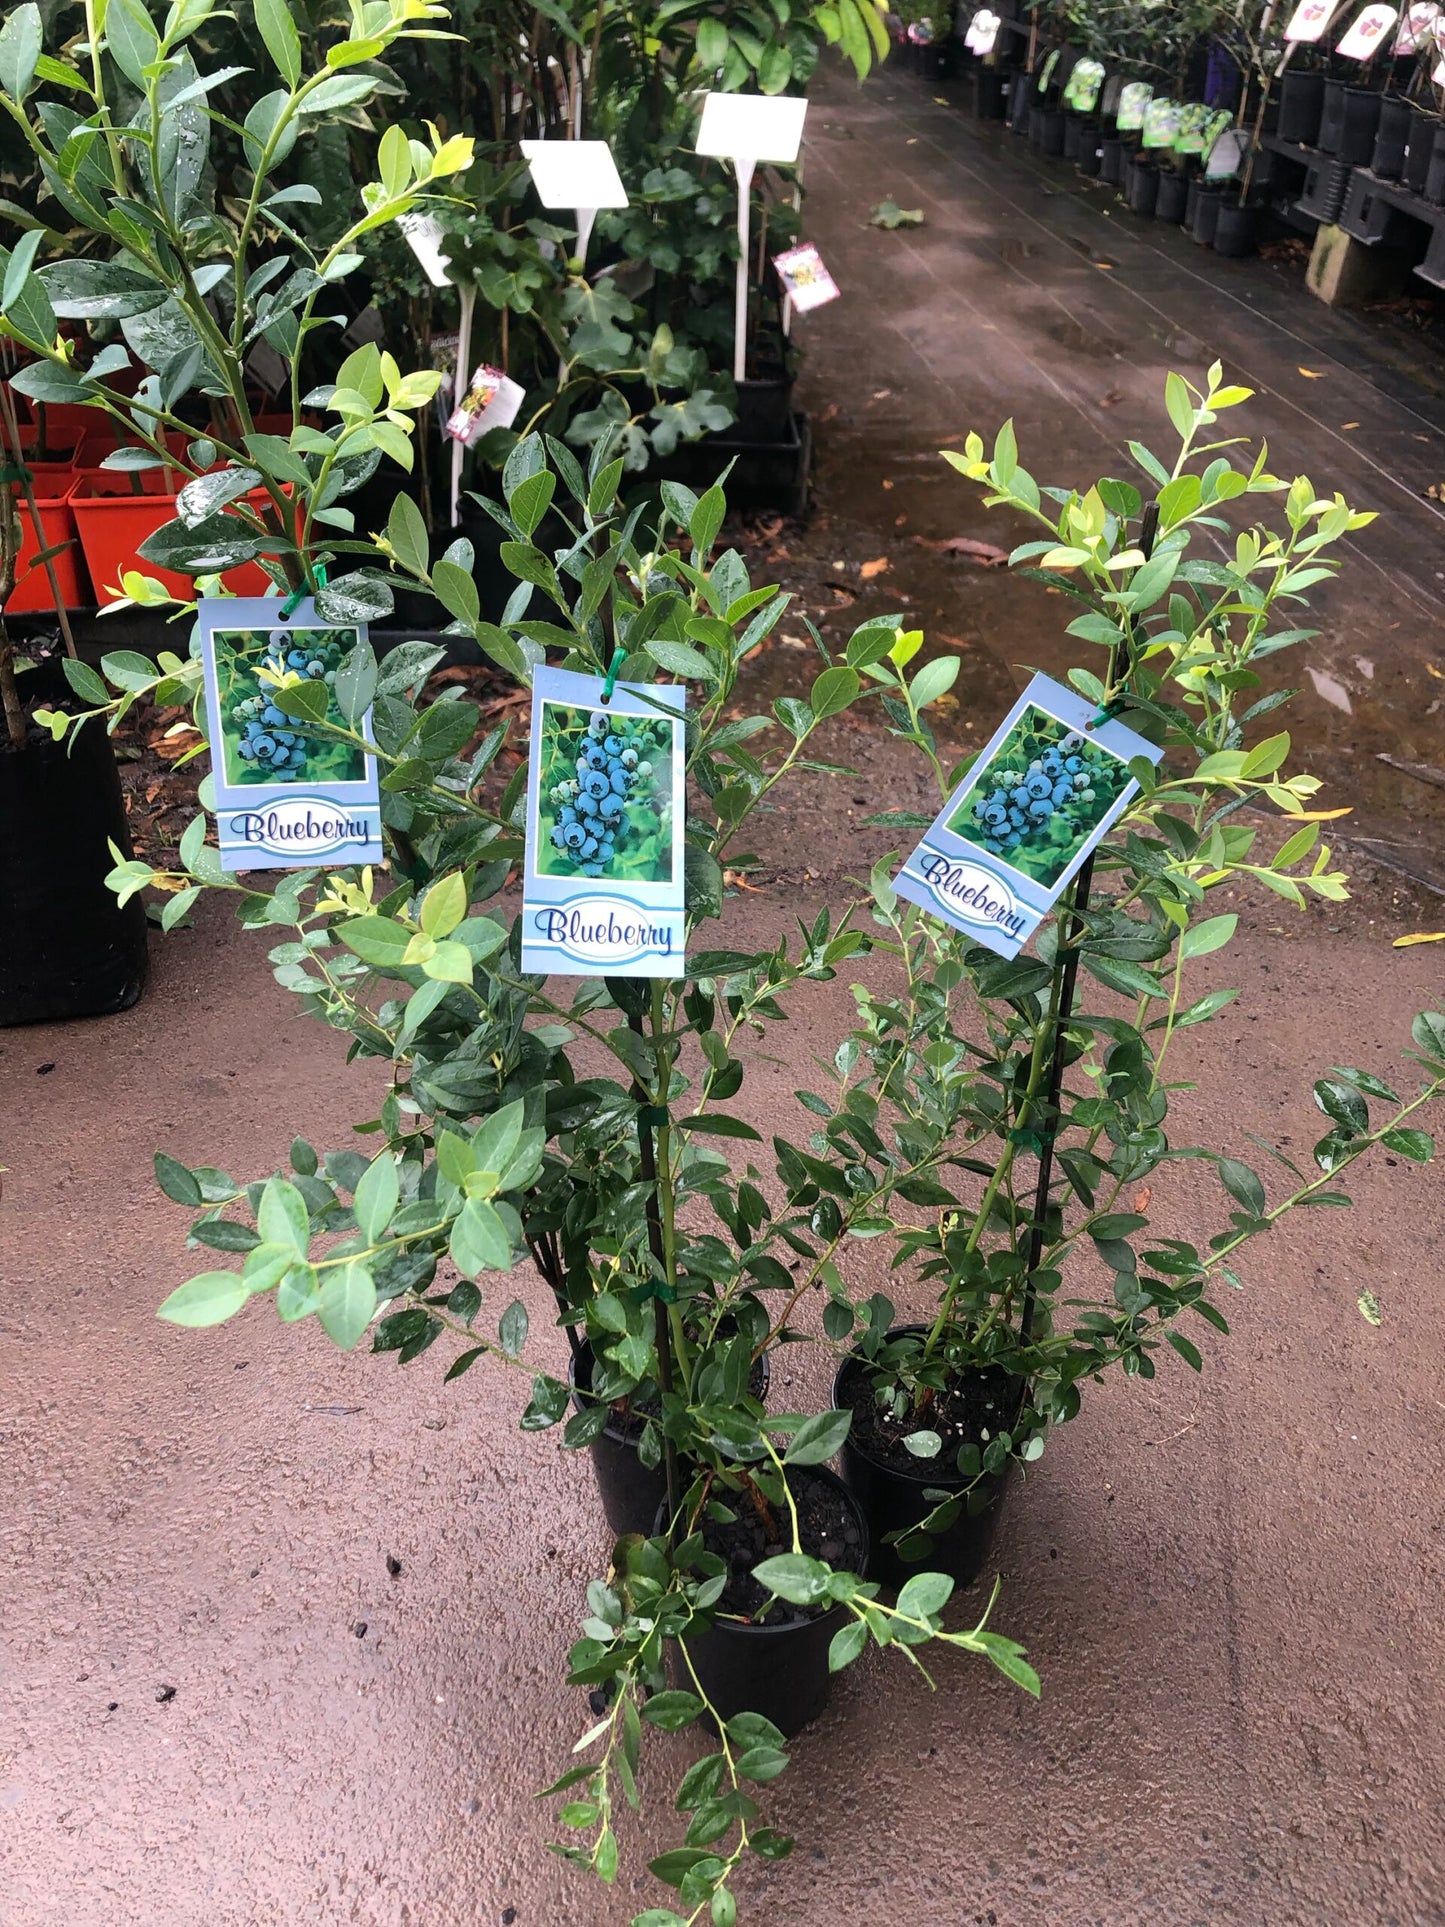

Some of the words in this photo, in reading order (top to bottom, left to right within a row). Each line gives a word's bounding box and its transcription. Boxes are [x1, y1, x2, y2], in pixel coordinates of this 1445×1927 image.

[230, 810, 368, 846] Blueberry
[920, 853, 1026, 939] Blueberry
[534, 908, 671, 956] Blueberry
